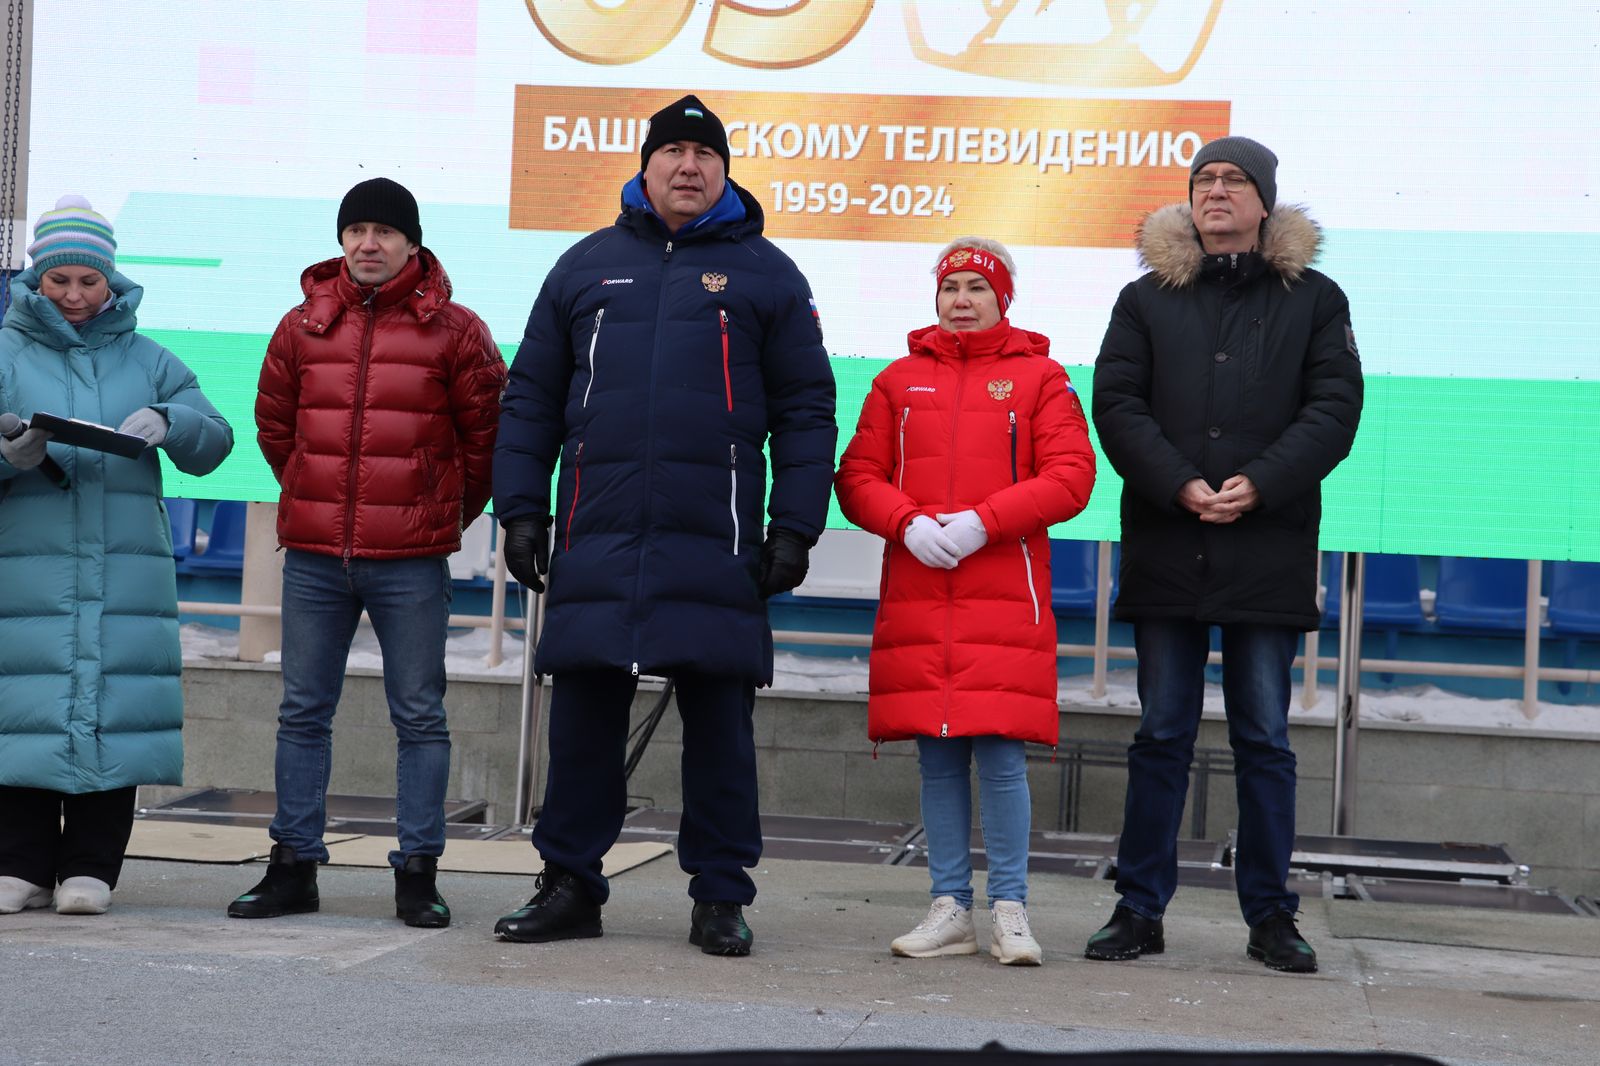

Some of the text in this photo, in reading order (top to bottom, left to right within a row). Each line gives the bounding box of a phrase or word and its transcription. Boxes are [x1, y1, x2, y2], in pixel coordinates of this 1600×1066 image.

[543, 116, 1203, 173] БАШСКОМУ ТЕЛЕВИДЕНИЮ
[771, 181, 954, 217] 1959-2024
